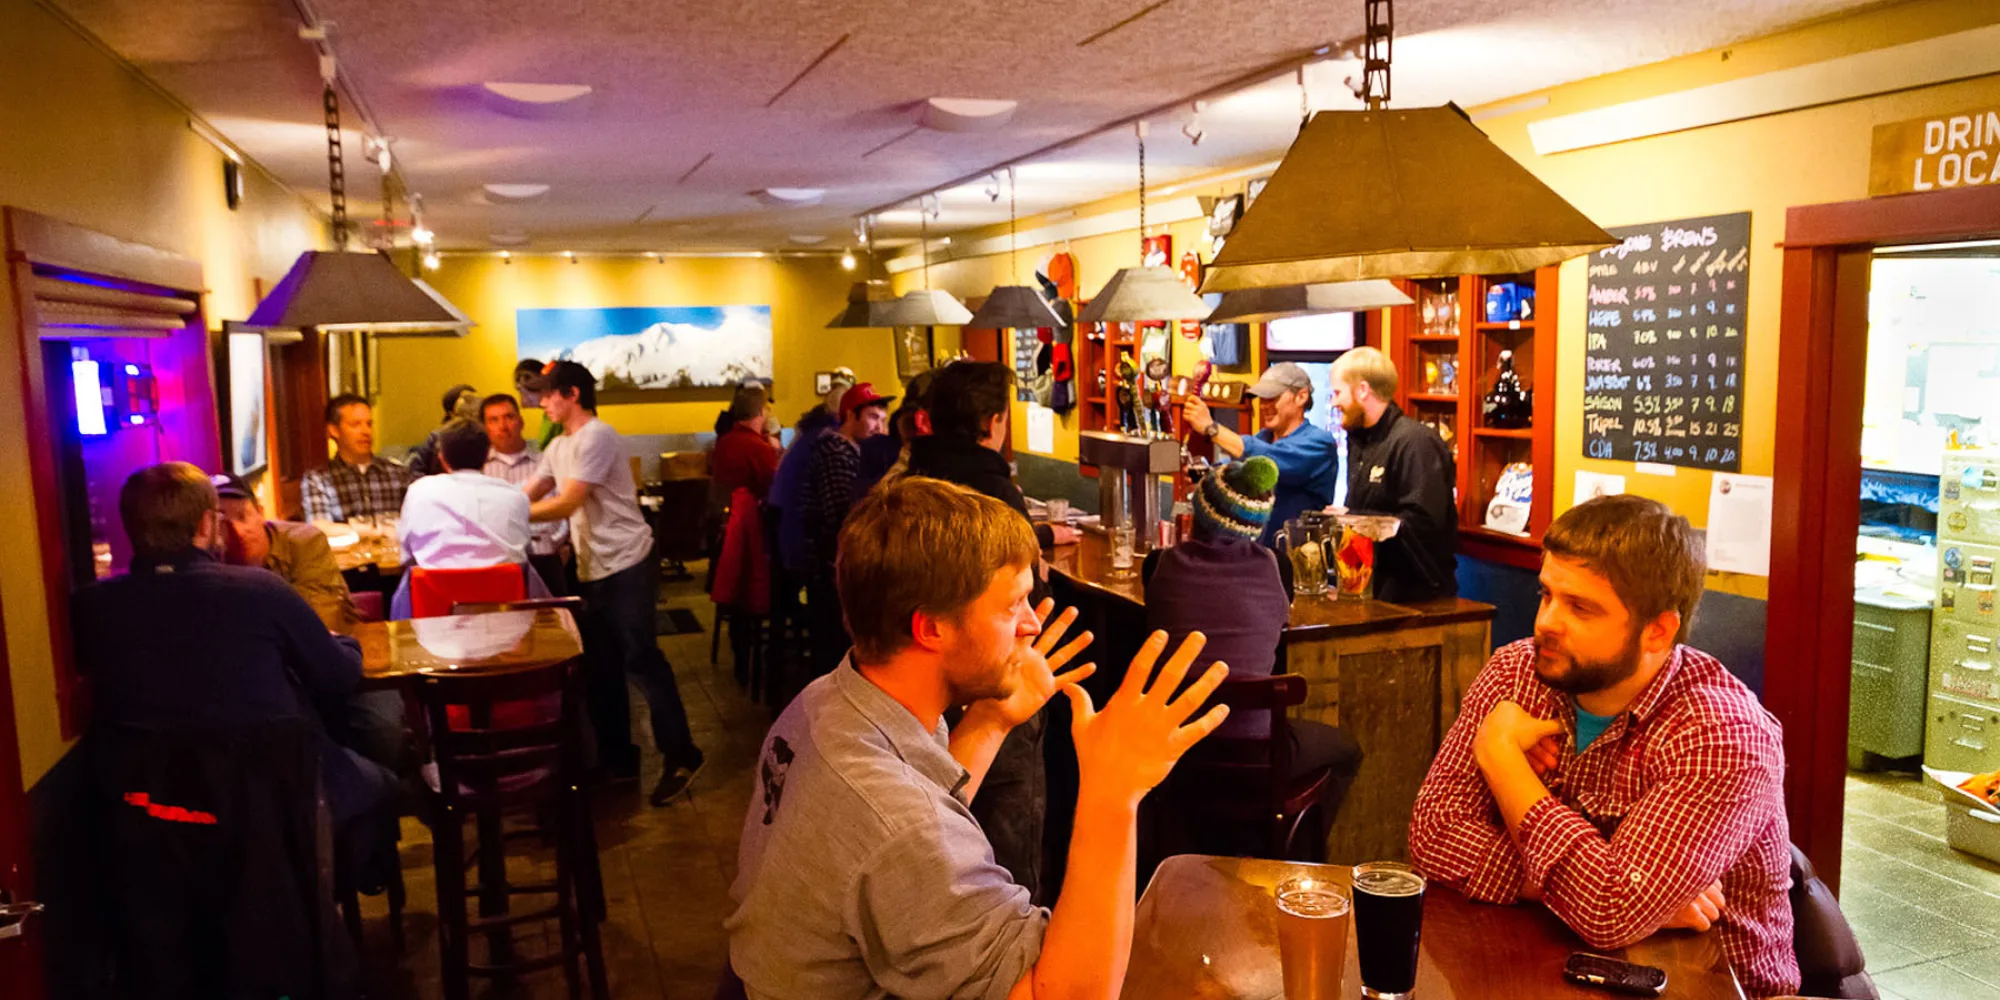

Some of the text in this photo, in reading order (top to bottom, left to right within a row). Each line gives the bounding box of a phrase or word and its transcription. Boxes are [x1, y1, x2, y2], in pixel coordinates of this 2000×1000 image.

[1588, 284, 1629, 305] AMBER
[1588, 332, 1607, 350] IPA
[1584, 391, 1622, 411] SAISON
[1633, 395, 1660, 415] 5.3%
[1692, 397, 1699, 412] 7
[1722, 395, 1735, 413] 18
[1705, 422, 1717, 435] 21
[1588, 440, 1612, 459] CDA
